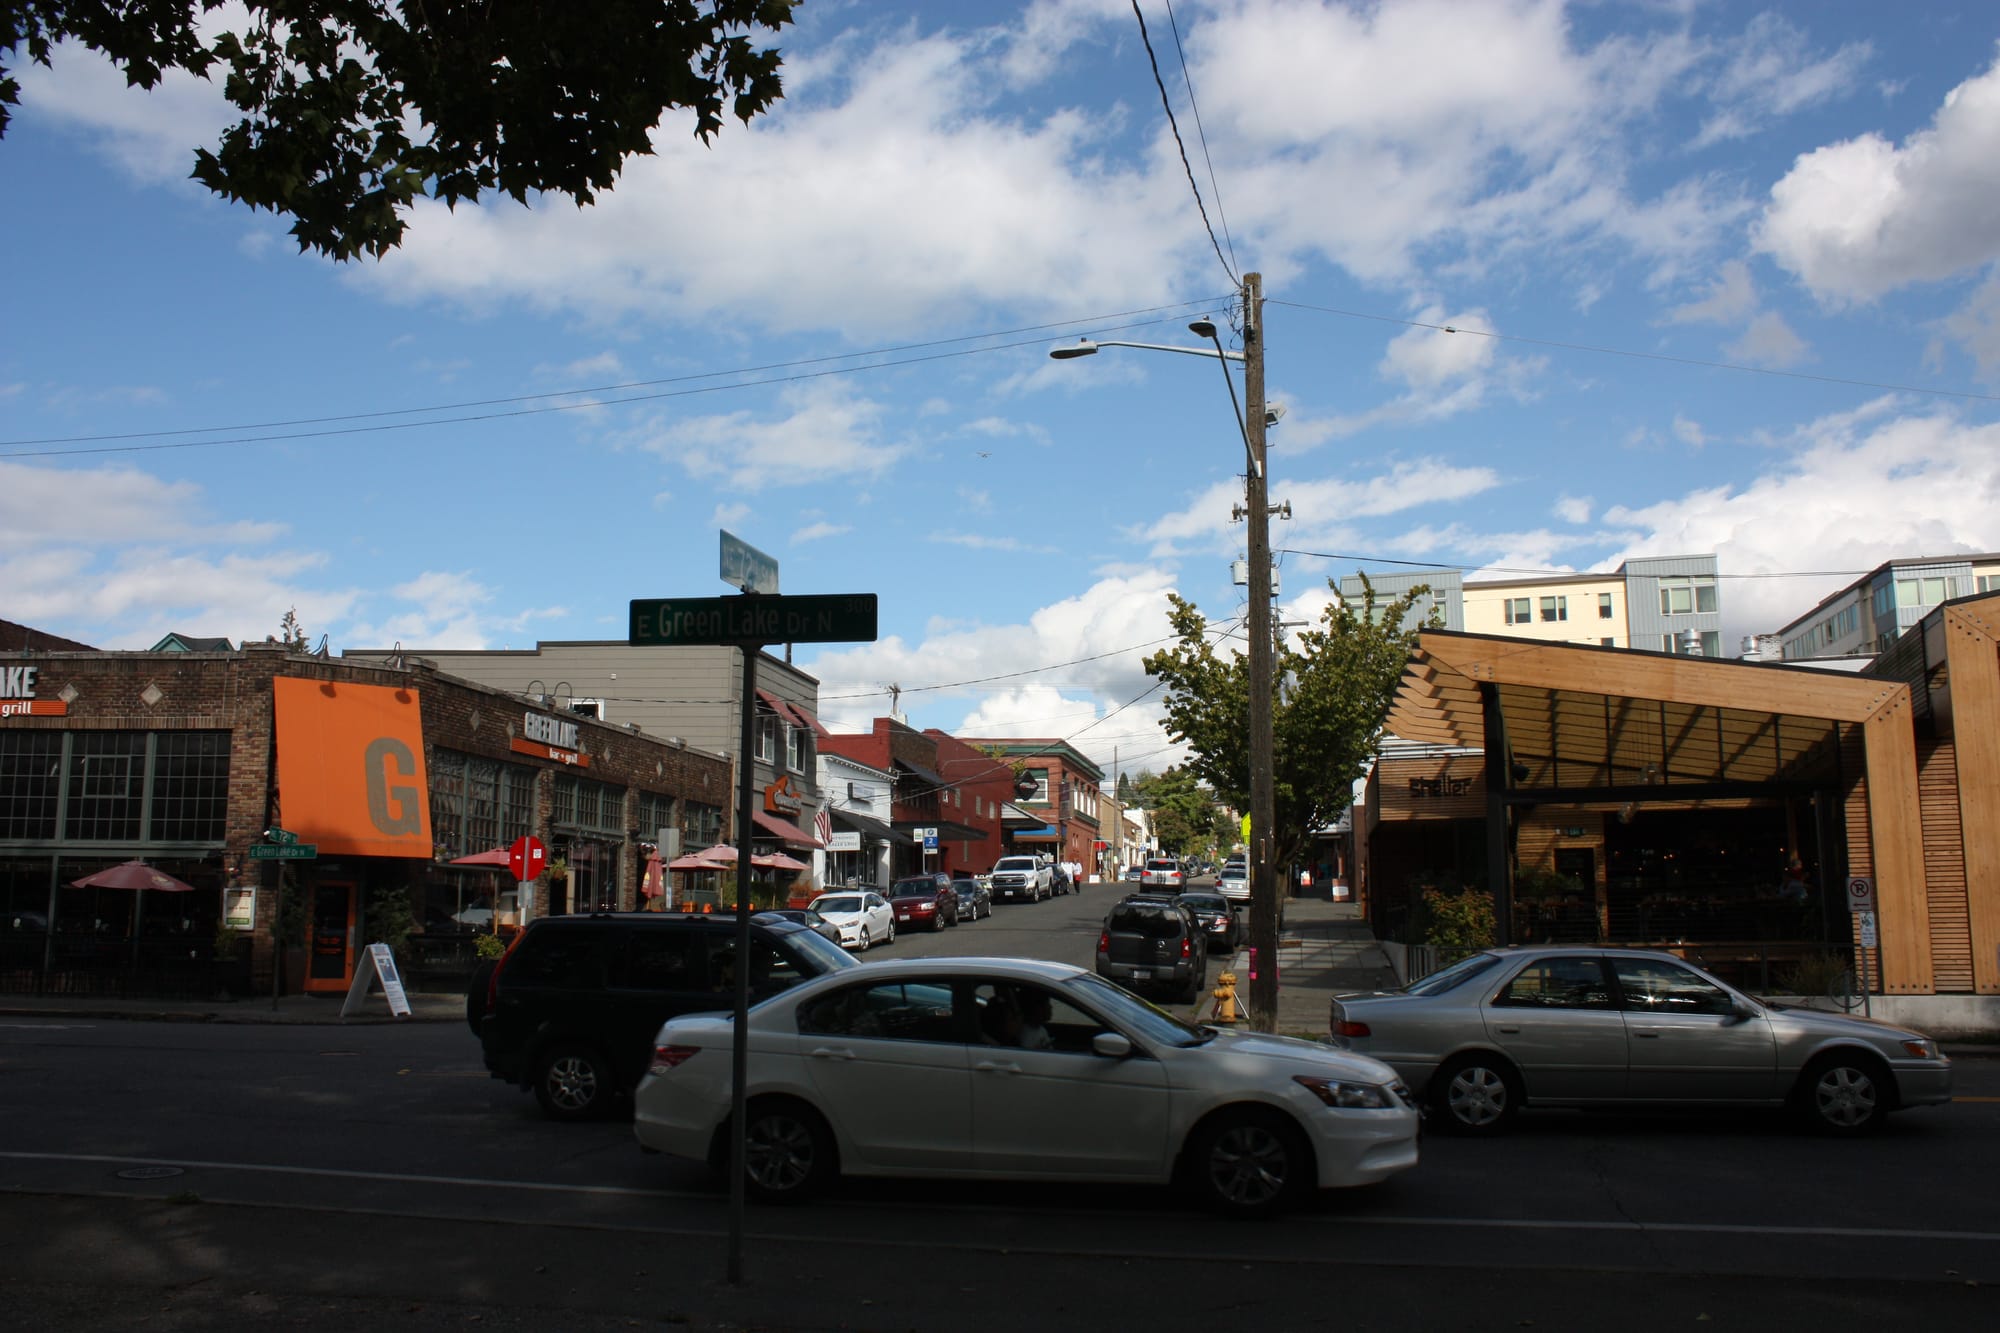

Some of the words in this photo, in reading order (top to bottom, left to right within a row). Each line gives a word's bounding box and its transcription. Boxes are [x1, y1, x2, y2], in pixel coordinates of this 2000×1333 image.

[846, 598, 873, 613] 300
[637, 615, 652, 638] E
[658, 603, 722, 637] Green
[727, 601, 779, 635] Lake
[786, 611, 810, 634] Dr
[817, 609, 833, 633] N
[2, 701, 32, 717] grill
[365, 736, 422, 836] G
